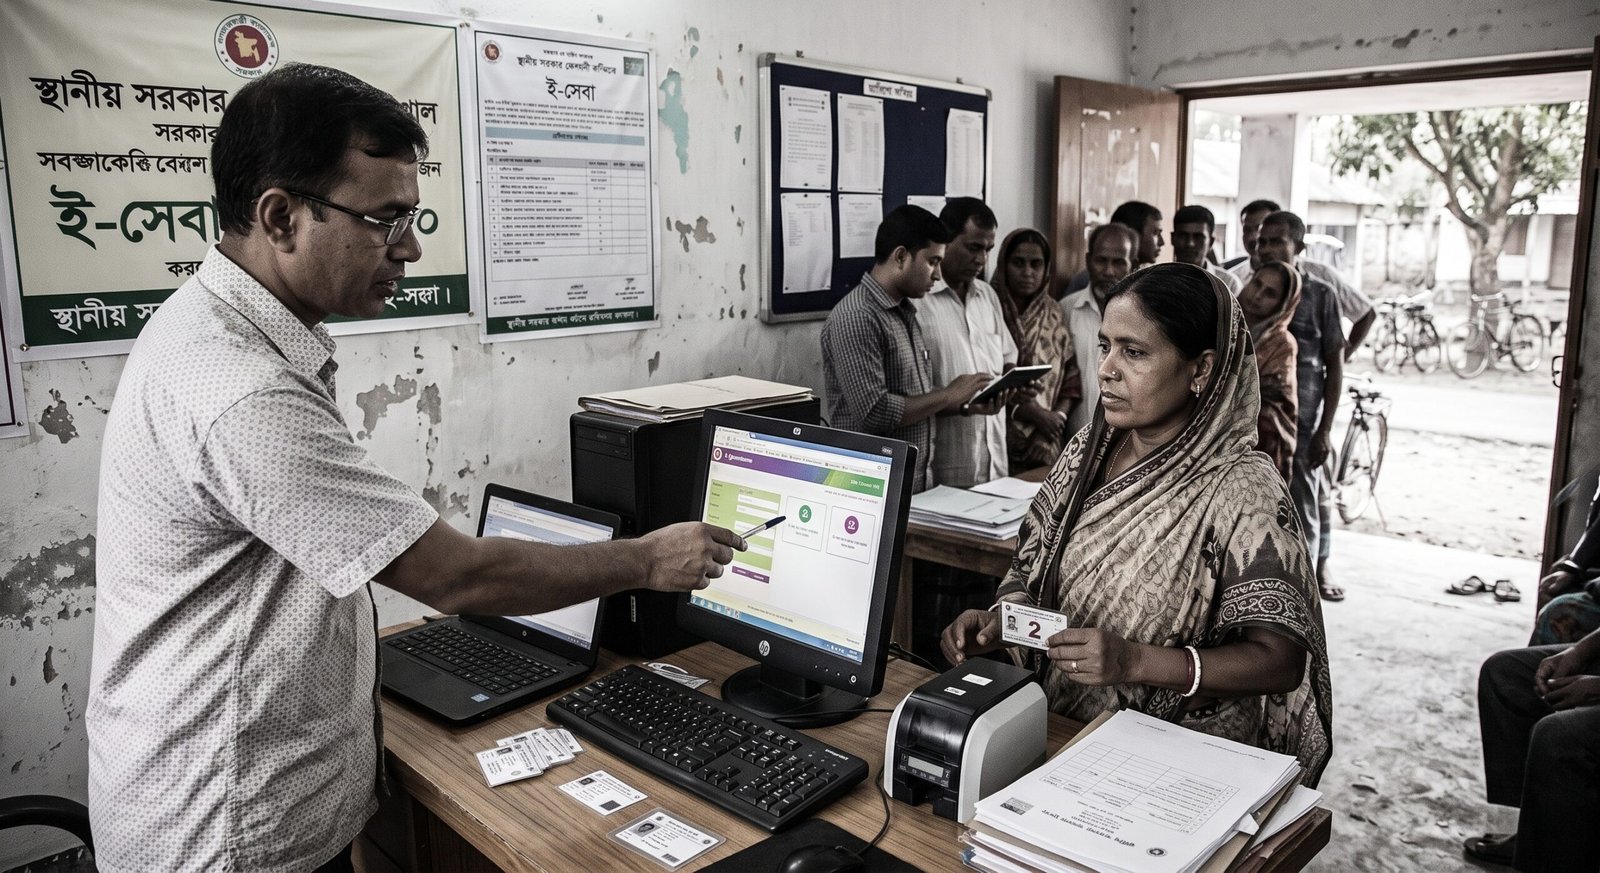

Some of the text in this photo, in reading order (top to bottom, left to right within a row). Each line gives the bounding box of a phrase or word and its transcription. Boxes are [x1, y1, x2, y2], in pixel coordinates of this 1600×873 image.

[29, 69, 124, 113] স্থানীয়
[131, 84, 228, 113] সরকার
[545, 76, 596, 102] ই-সেবা
[49, 184, 220, 250] ই-সেবা
[50, 297, 128, 335] স্থানীয়
[133, 302, 163, 320] স
[1028, 620, 1041, 640] 2
[759, 640, 769, 656] hp
